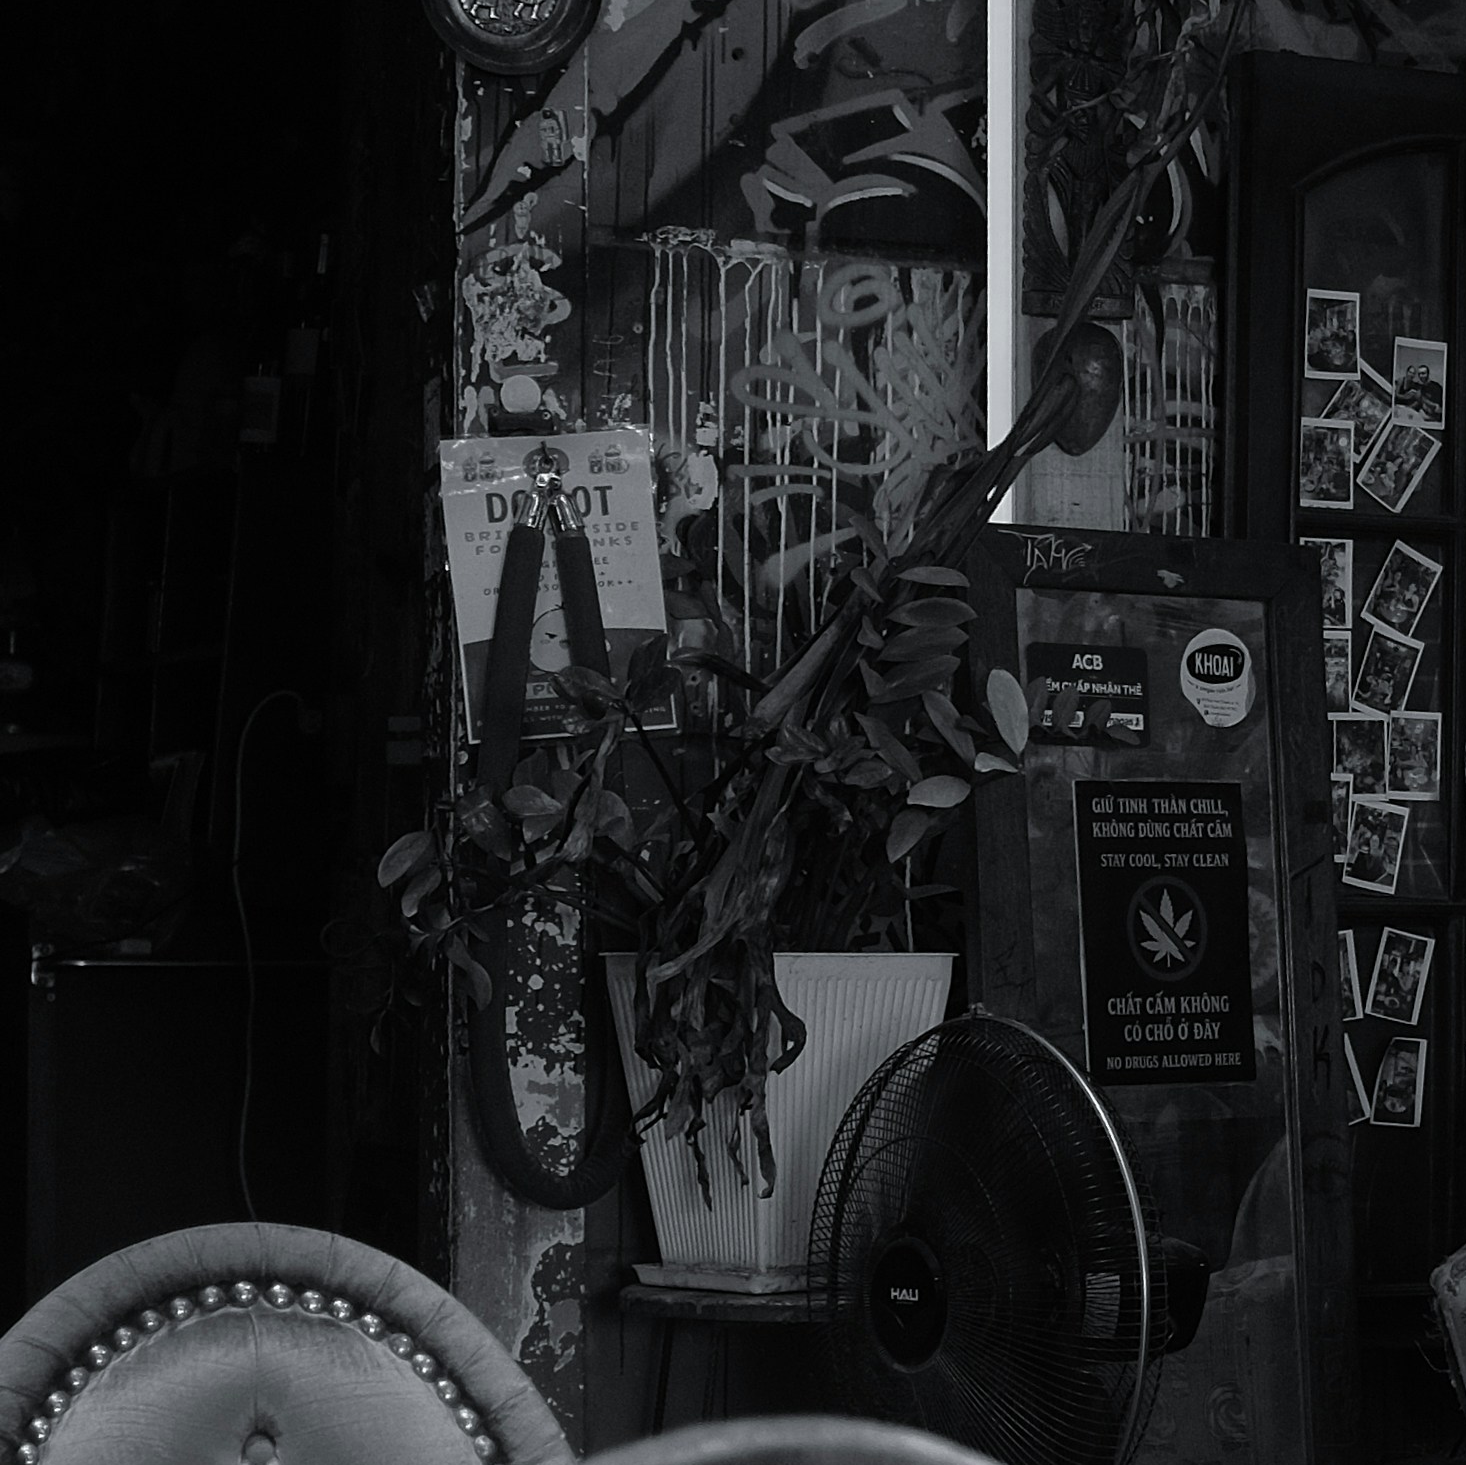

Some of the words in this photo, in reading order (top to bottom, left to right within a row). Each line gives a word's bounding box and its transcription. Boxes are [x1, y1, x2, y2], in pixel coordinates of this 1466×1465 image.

[1071, 653, 1104, 671] ACB
[1194, 651, 1235, 678] KHOAI
[1091, 794, 1115, 814] GIỮ
[1117, 797, 1148, 814] TINH
[1189, 798, 1229, 818] CHILL,
[1100, 853, 1127, 868] STAY
[1128, 853, 1162, 870] COOL,
[1163, 853, 1190, 868] STAY
[1192, 853, 1230, 868] CLEAN
[1107, 990, 1142, 1015] CHẤT
[1145, 990, 1176, 1015] CẤM
[1180, 992, 1231, 1014] KHÔNG
[1124, 1020, 1142, 1042] CÓ
[1192, 1018, 1222, 1040] ĐÂY
[1106, 1056, 1122, 1070] NO
[1124, 1055, 1160, 1070] DRUGS
[1161, 1052, 1212, 1068] ALLOWED
[1214, 1051, 1242, 1066] HERE
